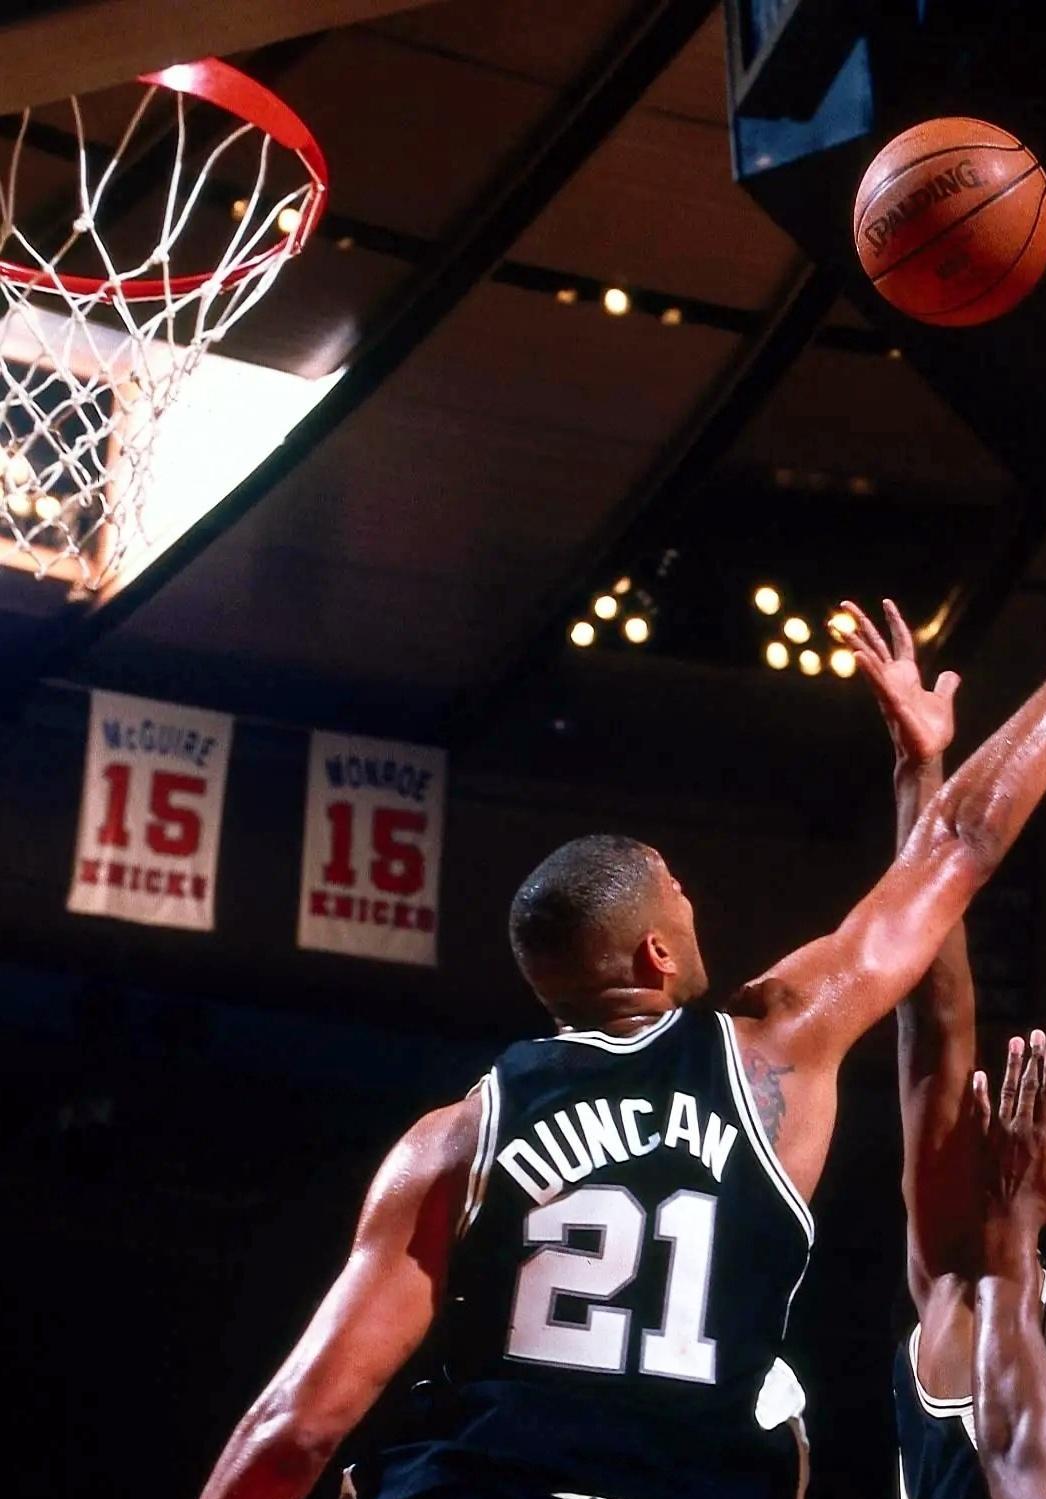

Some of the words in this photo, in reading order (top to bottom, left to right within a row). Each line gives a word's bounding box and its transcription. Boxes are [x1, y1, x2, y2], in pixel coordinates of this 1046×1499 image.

[97, 763, 208, 858] 15
[323, 801, 428, 896] 15
[78, 858, 209, 902] KNICKS
[308, 890, 436, 934] KNICKS
[496, 1091, 739, 1206] DUNCAN
[502, 1183, 718, 1385] 21
